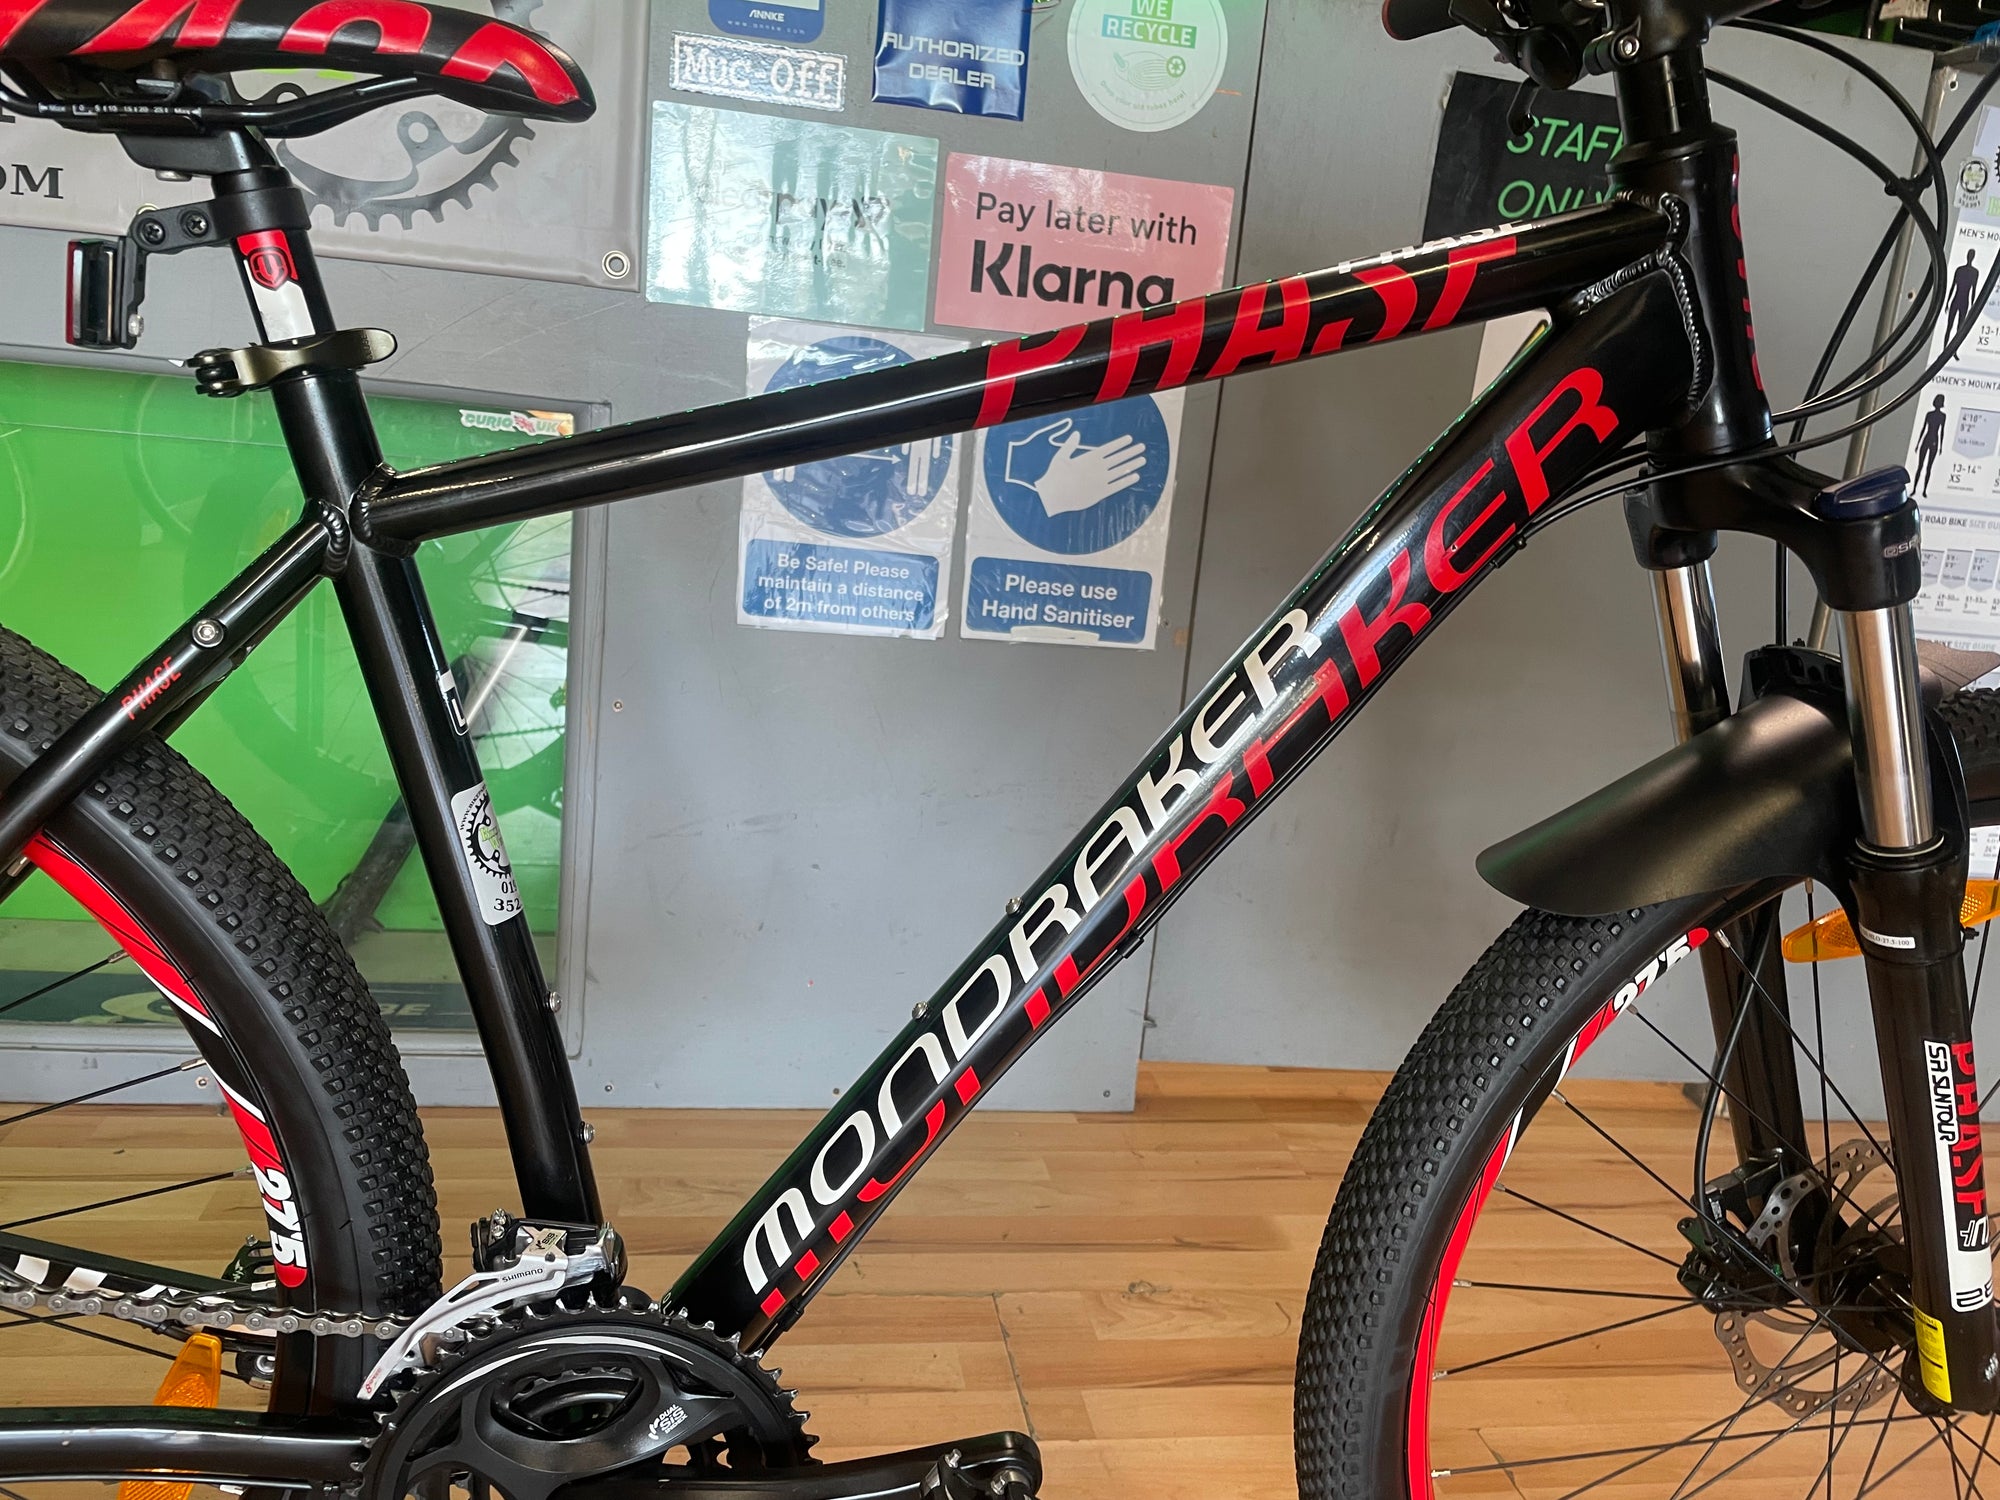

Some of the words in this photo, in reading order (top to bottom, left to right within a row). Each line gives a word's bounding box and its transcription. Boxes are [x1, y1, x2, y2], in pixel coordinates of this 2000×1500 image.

[1136, 0, 1168, 17] WE
[1106, 18, 1192, 46] RECYCLE
[883, 31, 1025, 66] AUTHORIZED
[682, 45, 836, 100] Muc-Off
[909, 63, 996, 89] DEALER
[976, 191, 1036, 232] Pay
[1046, 199, 1120, 236] later
[1131, 212, 1198, 246] with
[970, 239, 1175, 310] Klarna
[777, 553, 801, 569] Be
[805, 555, 849, 573] Safe!
[853, 560, 910, 580] Please
[758, 574, 833, 594] maintain
[837, 583, 848, 595] a
[852, 580, 925, 602] distance
[1004, 573, 1075, 599] Please
[1080, 584, 1118, 601] use
[763, 595, 781, 611] of
[784, 596, 813, 613] 2m
[816, 598, 858, 618] from
[861, 603, 916, 623] others
[981, 599, 1038, 622] Hand
[1043, 604, 1136, 630] Sanitiser
[121, 656, 182, 720] PHASE
[743, 608, 1322, 1295] MONDRAKER
[501, 1268, 544, 1283] SHIMANO
[659, 1404, 680, 1421] DUAL
